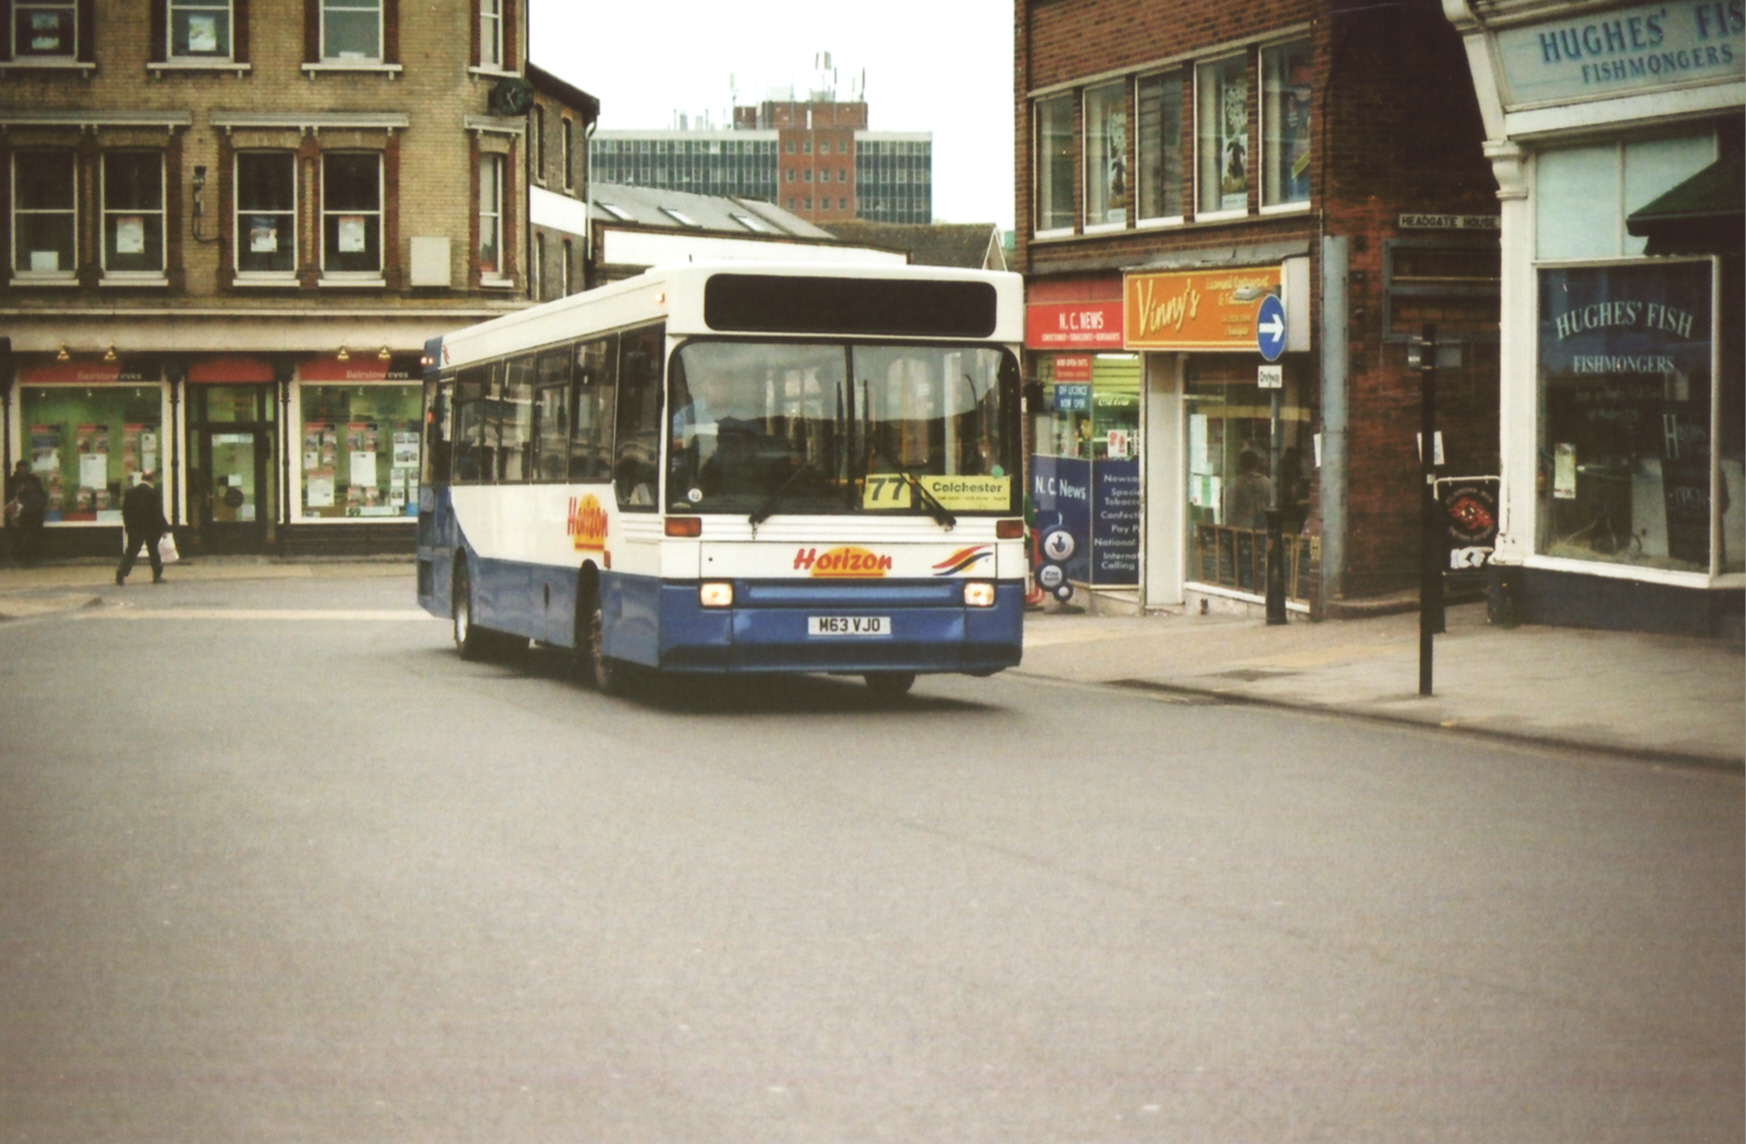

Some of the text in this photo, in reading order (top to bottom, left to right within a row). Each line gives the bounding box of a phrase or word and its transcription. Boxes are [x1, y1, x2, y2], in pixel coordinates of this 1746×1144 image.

[1539, 9, 1668, 63] HUGHES'
[1580, 44, 1734, 84] FISHMONGERS
[1401, 216, 1498, 229] HEADGATE HOUSE
[1136, 277, 1200, 337] Vinny's
[1059, 310, 1104, 330] N. C. NEWS
[1555, 301, 1694, 340] HUGHES' FISH
[1573, 355, 1675, 374] FISHMONGERS
[867, 477, 1003, 500] 77 Colchester
[1035, 474, 1046, 495] N.
[1059, 478, 1087, 501] News
[567, 495, 608, 539] Horizon
[1111, 524, 1129, 535] Pay
[1094, 538, 1136, 546] National
[793, 548, 892, 571] Horizon
[1101, 561, 1135, 572] Calling
[819, 618, 881, 632] M63 VJO
